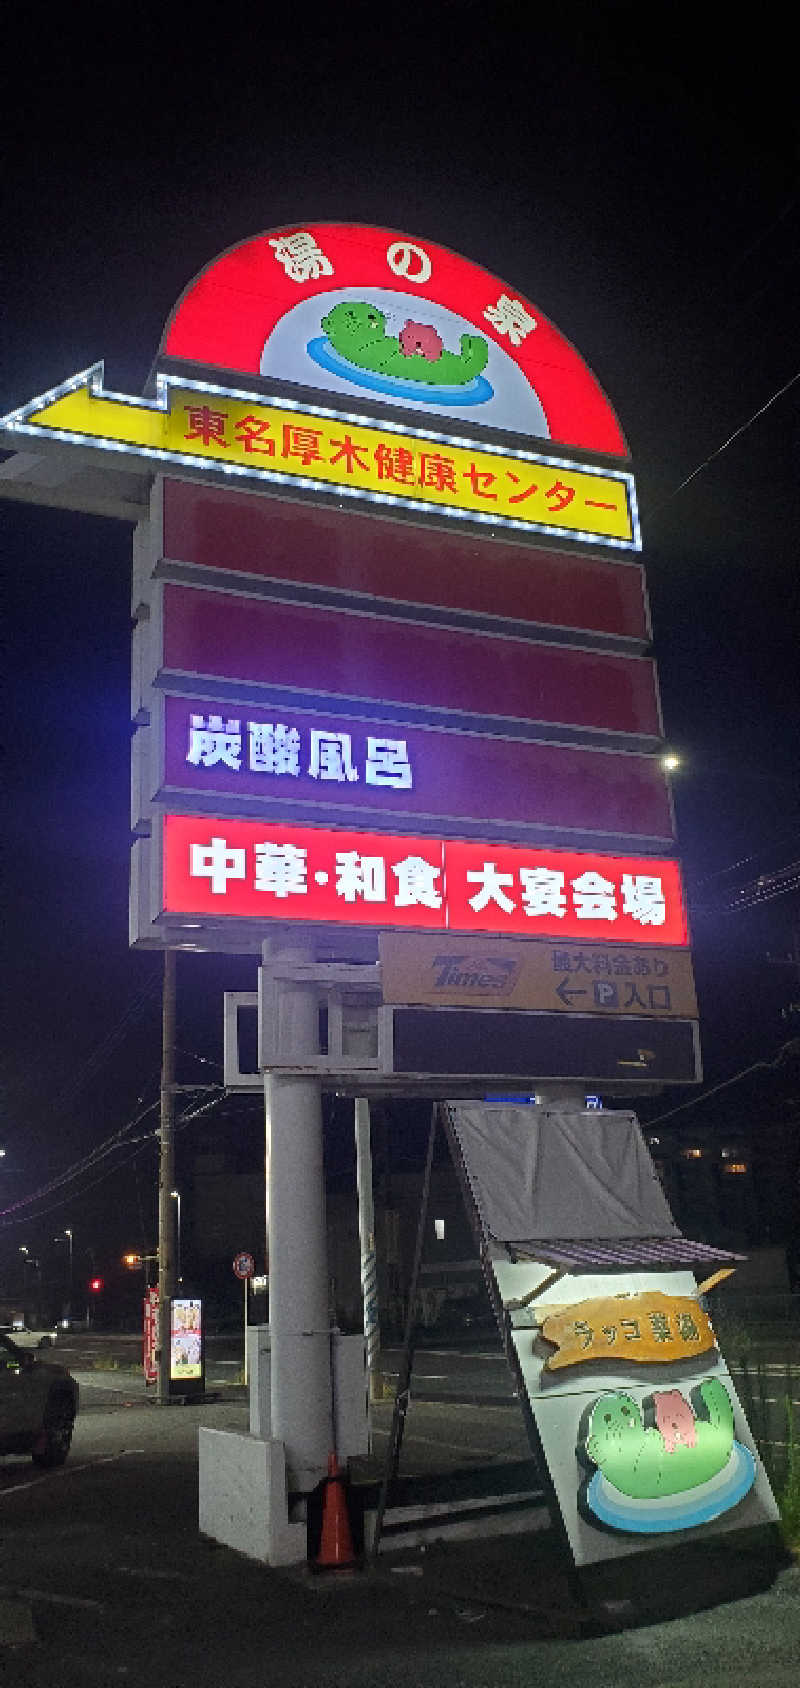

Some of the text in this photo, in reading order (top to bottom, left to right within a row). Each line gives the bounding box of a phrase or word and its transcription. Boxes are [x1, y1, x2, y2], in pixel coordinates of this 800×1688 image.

[184, 405, 618, 511] 東名厚木健康センター
[186, 715, 413, 788] 炭酸風呂
[189, 838, 666, 925] 中華・和食 大宴会場
[432, 956, 514, 989] Times
[552, 949, 669, 977] 最大料金あり
